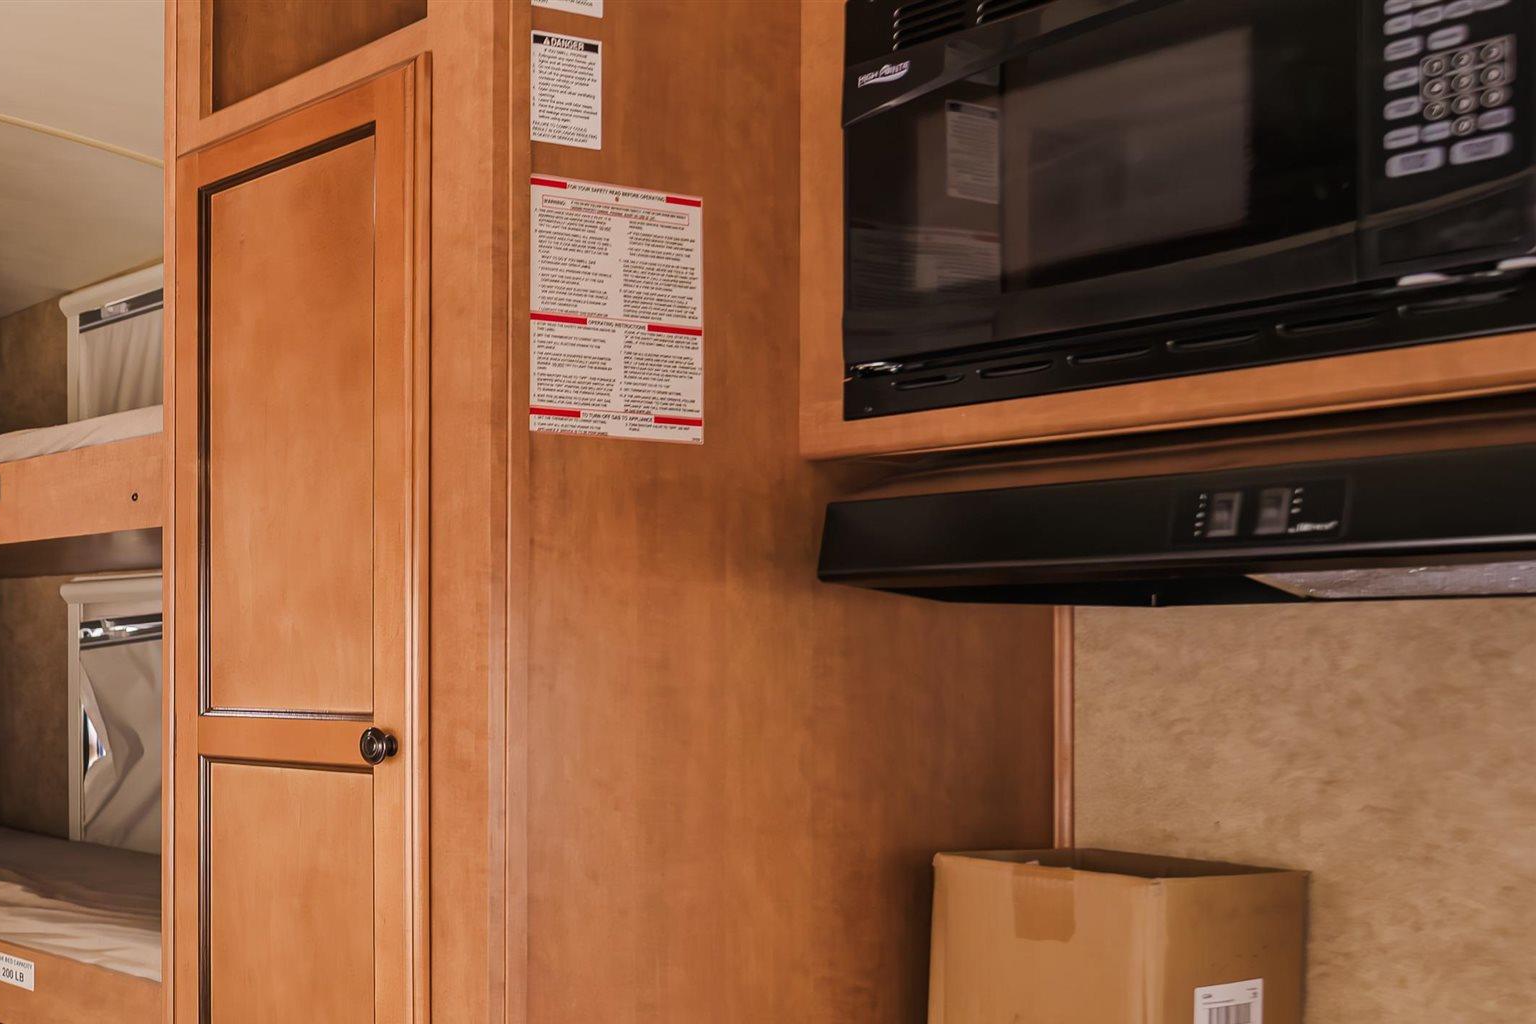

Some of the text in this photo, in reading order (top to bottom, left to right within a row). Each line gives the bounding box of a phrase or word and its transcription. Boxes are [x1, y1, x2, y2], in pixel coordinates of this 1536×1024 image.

[550, 37, 585, 51] DANGER
[2, 966, 24, 982] 200 LB
